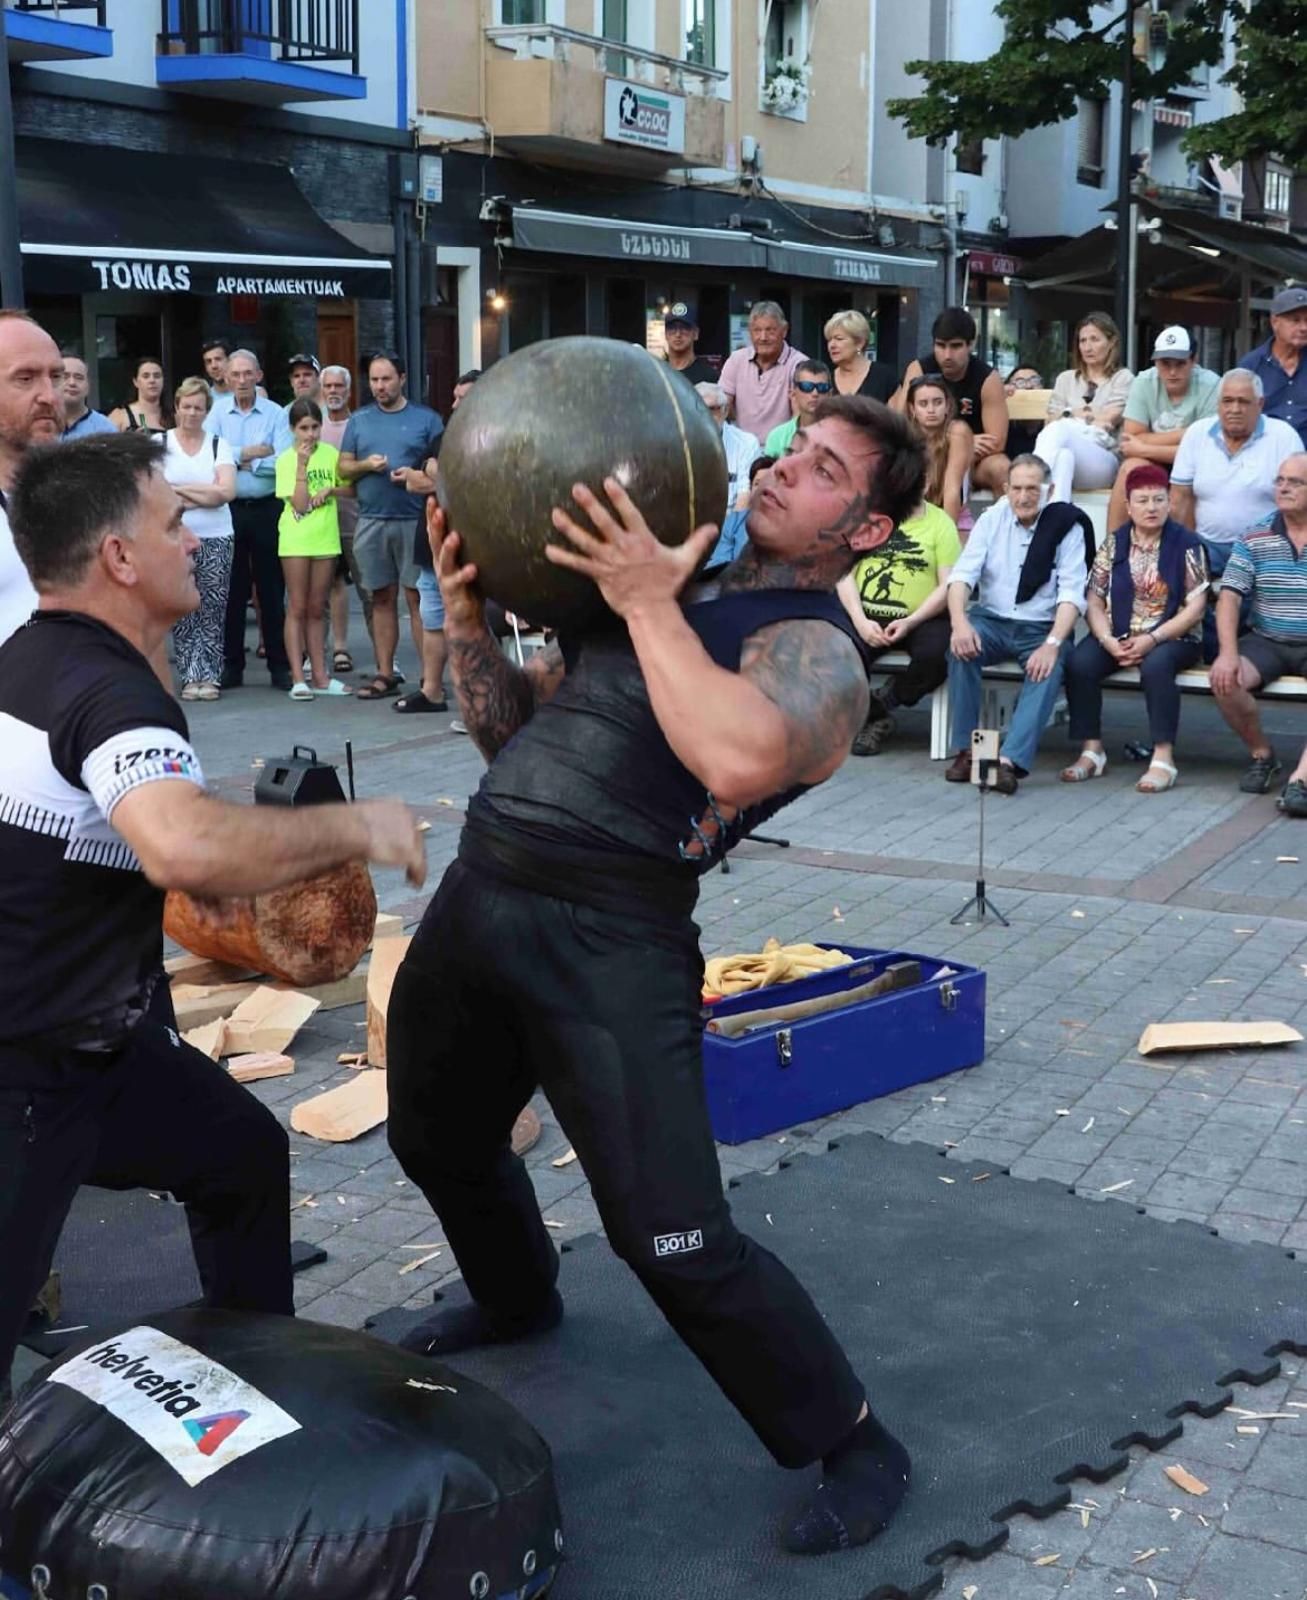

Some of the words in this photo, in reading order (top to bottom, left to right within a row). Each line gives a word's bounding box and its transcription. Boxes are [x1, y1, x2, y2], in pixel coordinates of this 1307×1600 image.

[91, 261, 191, 291] TOMAS
[216, 277, 345, 297] APARTAMENTUAK
[84, 1342, 202, 1419] helvetia
